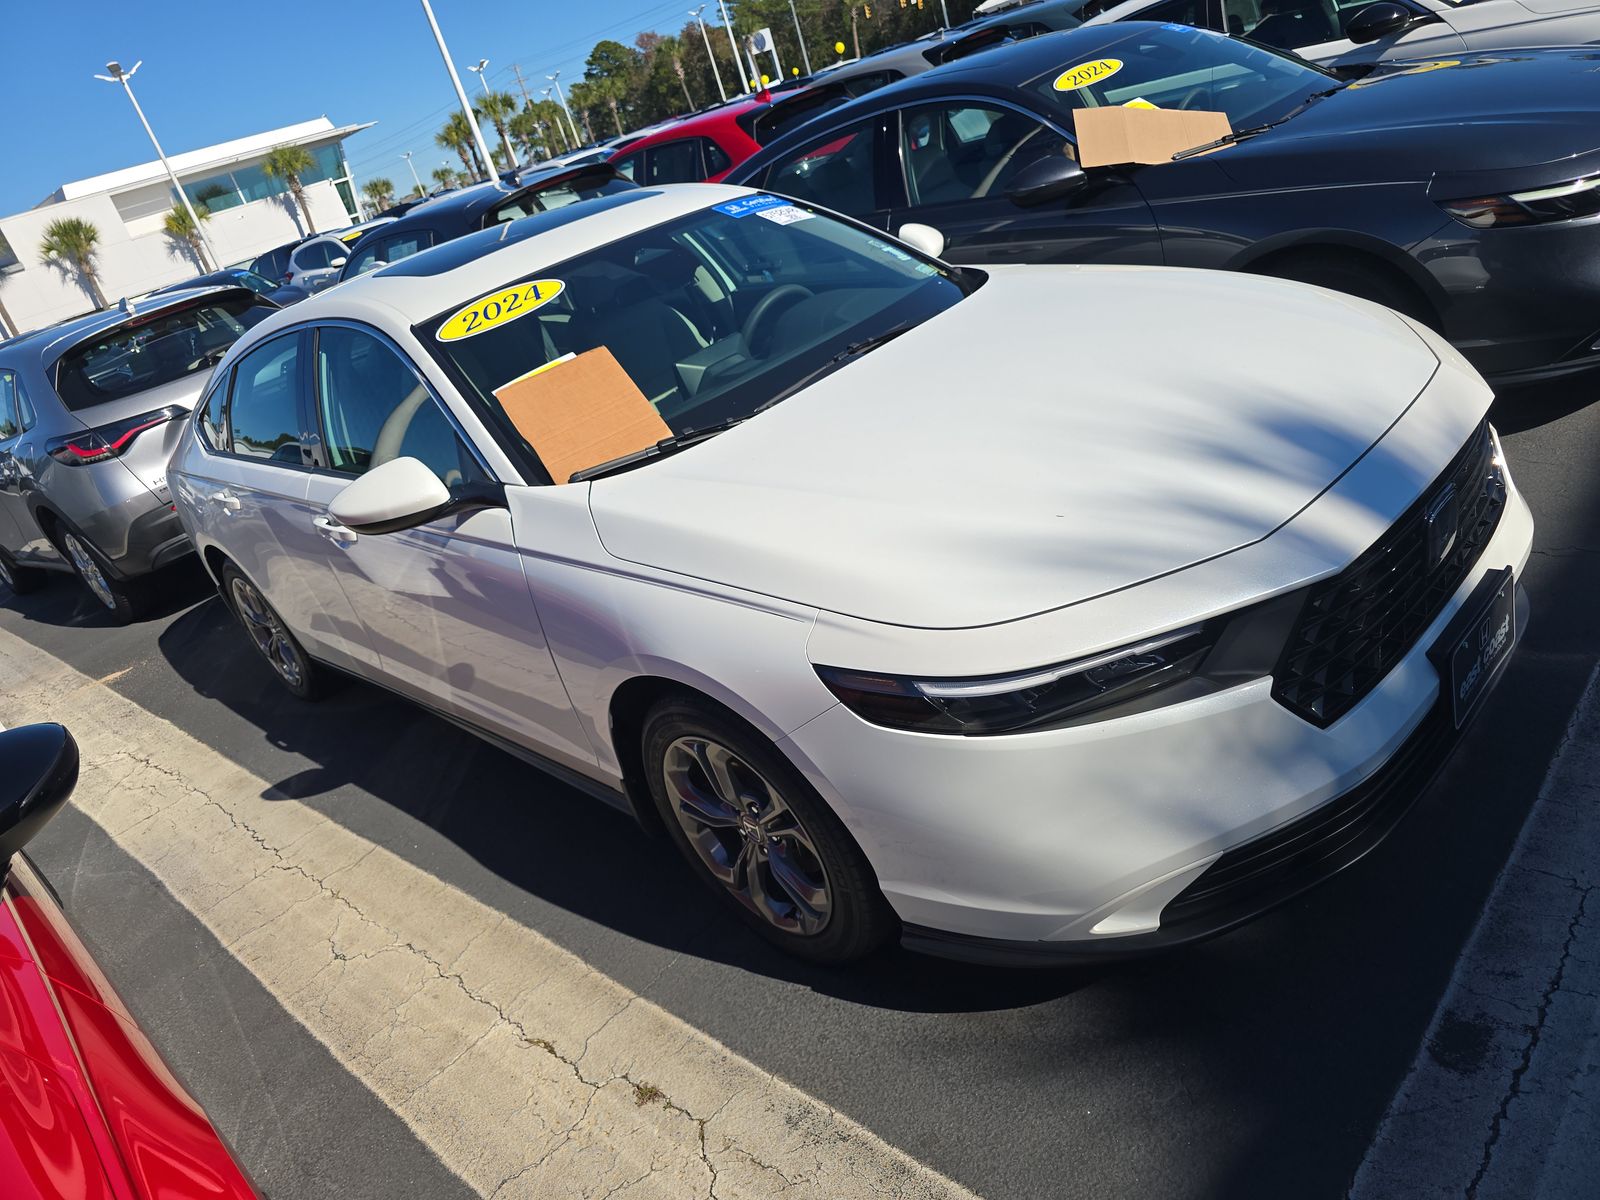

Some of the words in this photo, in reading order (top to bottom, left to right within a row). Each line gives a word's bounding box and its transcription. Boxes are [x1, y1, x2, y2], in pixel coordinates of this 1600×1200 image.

[1066, 61, 1112, 86] 2024
[462, 284, 545, 333] 2024
[1483, 613, 1509, 663] coast
